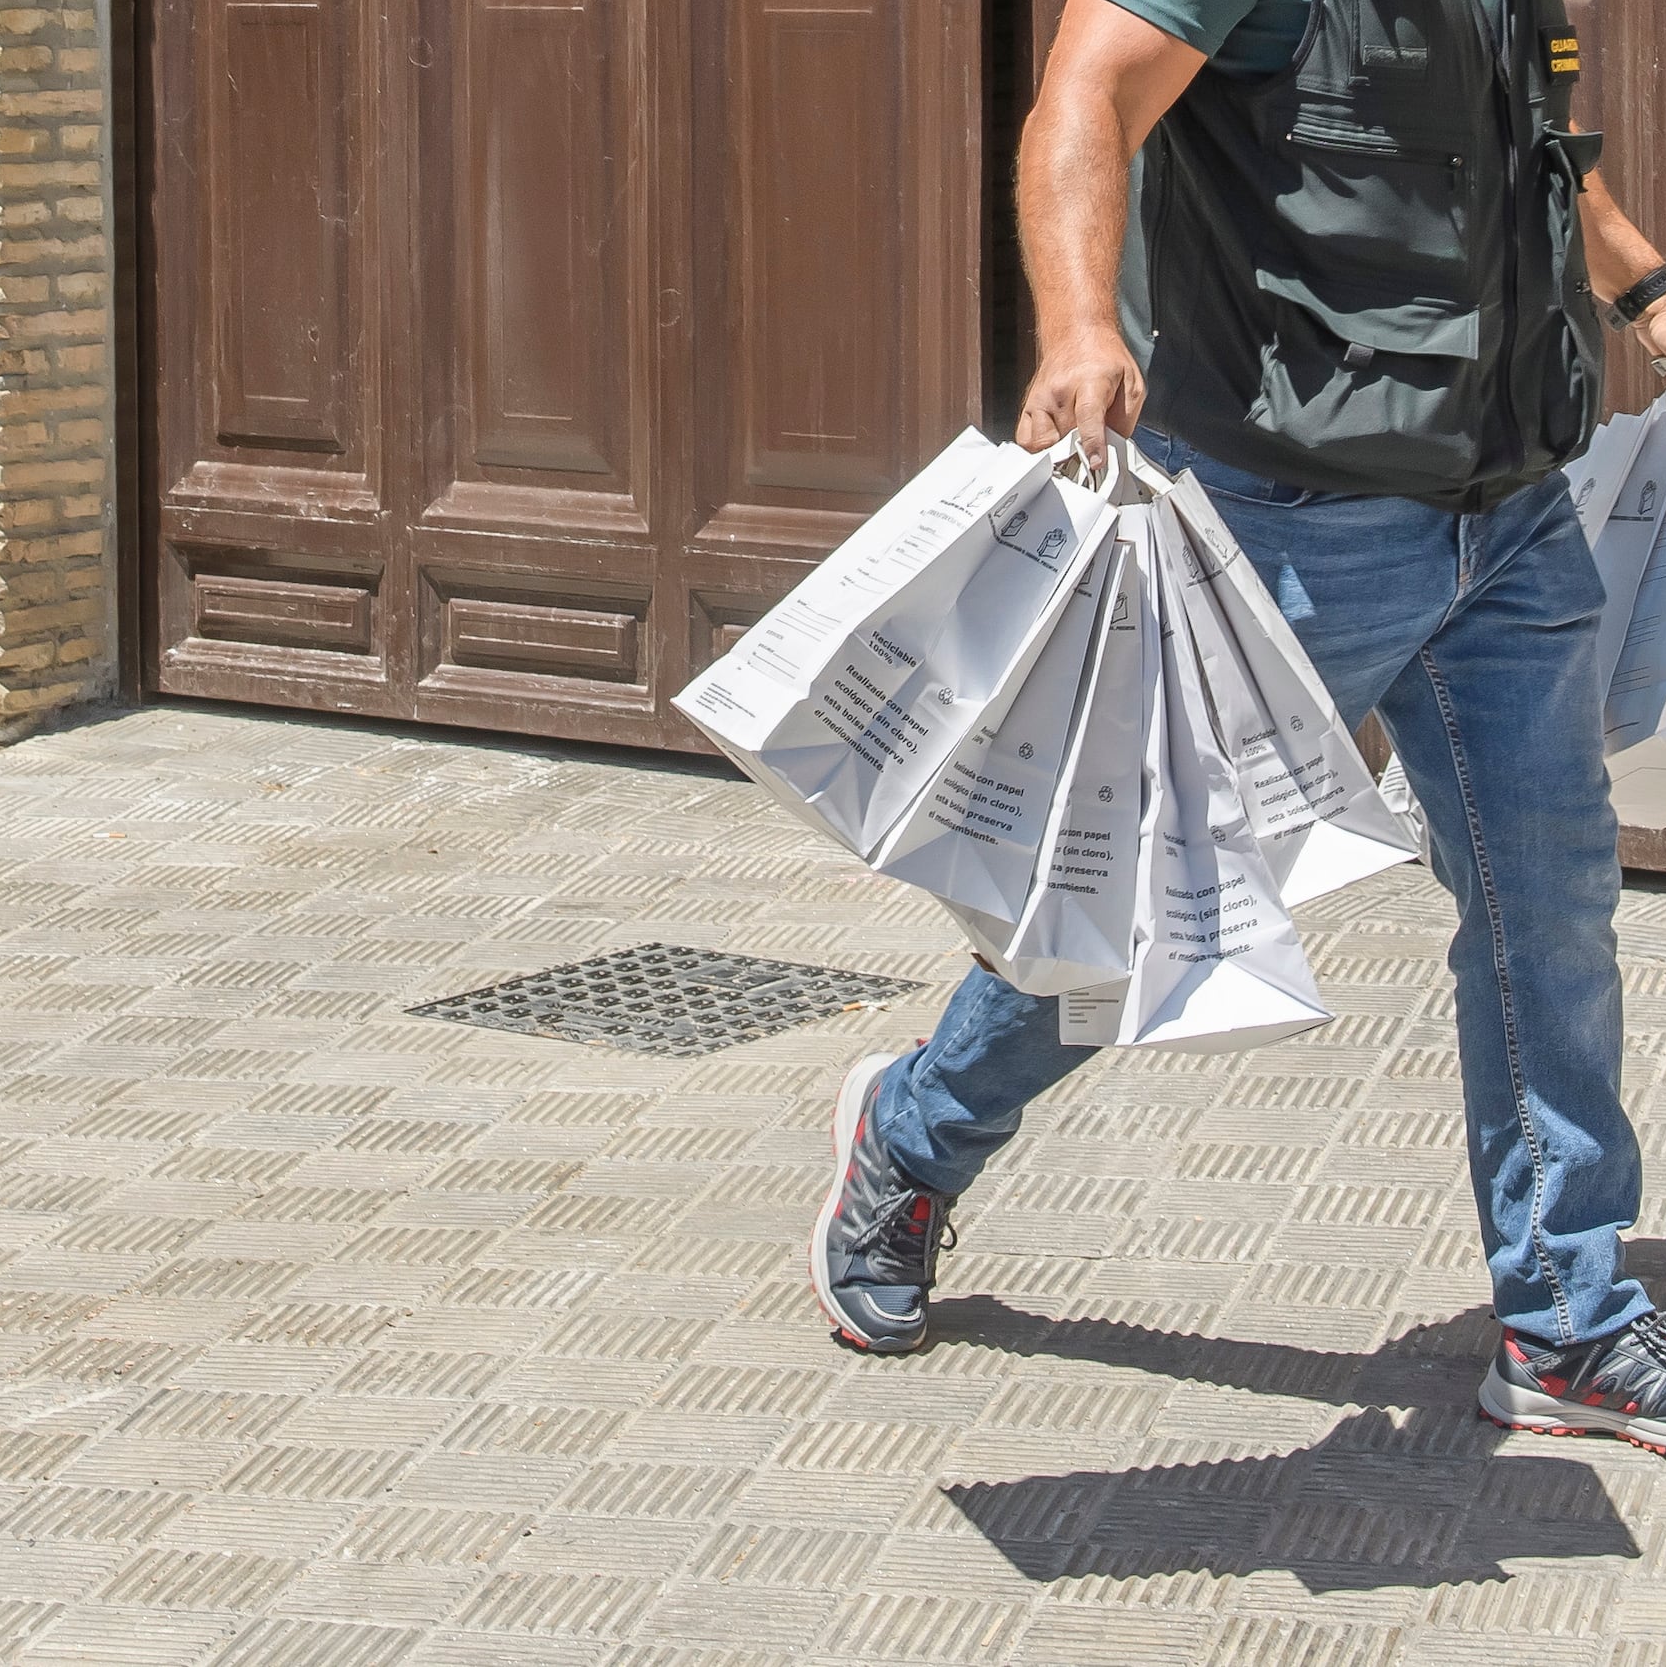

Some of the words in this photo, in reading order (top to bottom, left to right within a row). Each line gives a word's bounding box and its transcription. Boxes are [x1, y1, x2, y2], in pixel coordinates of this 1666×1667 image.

[868, 640, 894, 666] 100%
[872, 630, 917, 668] Reciclable
[845, 664, 887, 702] Realizada
[885, 698, 903, 716] con
[901, 713, 930, 737] papel
[823, 693, 842, 712] esta
[841, 708, 866, 732] bolsa
[863, 728, 905, 766] preserva
[834, 678, 874, 716] ecológico
[872, 710, 891, 730] (sin
[890, 728, 919, 755] cloro),
[813, 707, 822, 719] el
[822, 715, 885, 774] medioambiente.
[1253, 770, 1293, 790] Realizada
[1293, 765, 1306, 776] con
[1305, 753, 1325, 770] papel
[975, 775, 994, 787] con
[995, 782, 1026, 798] papel
[1260, 788, 1299, 807] ecológico
[934, 793, 949, 806] esta
[949, 800, 966, 815] bolsa
[965, 809, 1014, 833] preserva
[969, 790, 988, 805] (sin
[989, 797, 1023, 818] cloro),
[1267, 811, 1286, 824] esta
[1310, 785, 1346, 809] preserva
[935, 813, 999, 846] medioambiente.
[1084, 831, 1111, 841] papel
[1273, 830, 1282, 841] el
[1063, 845, 1080, 856] (sin
[1081, 847, 1114, 861] cloro),
[1064, 865, 1109, 877] preserva
[1047, 881, 1099, 895] ambiente.
[1195, 886, 1216, 899] con
[1217, 873, 1247, 895] papel
[1198, 907, 1221, 923] (sin
[1221, 894, 1259, 914] cloro),
[1208, 917, 1259, 944] preserva
